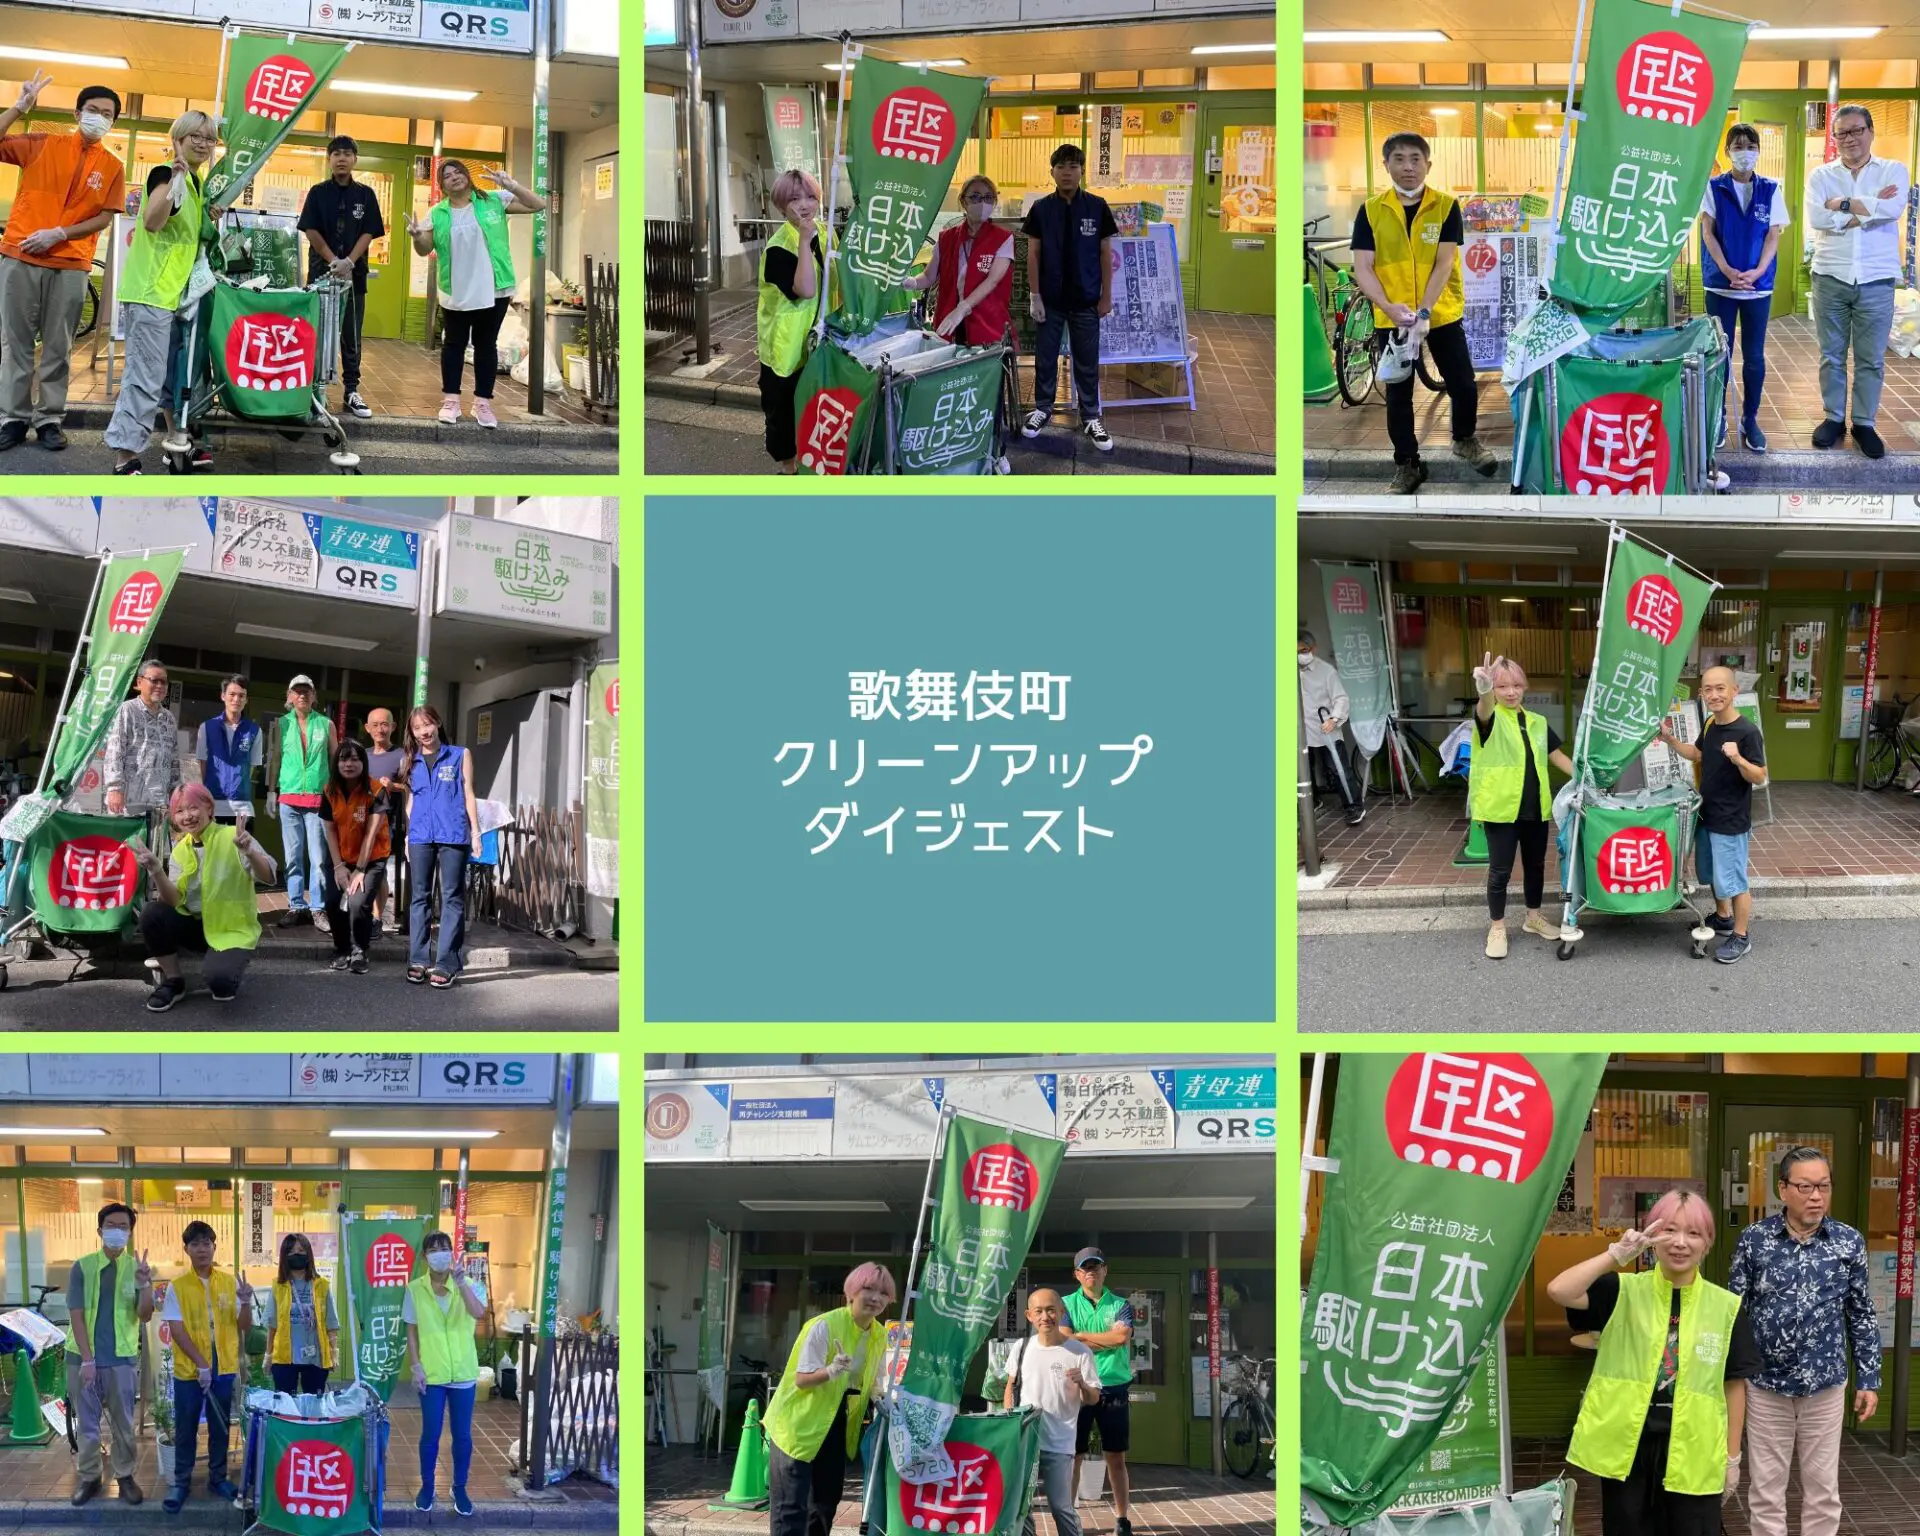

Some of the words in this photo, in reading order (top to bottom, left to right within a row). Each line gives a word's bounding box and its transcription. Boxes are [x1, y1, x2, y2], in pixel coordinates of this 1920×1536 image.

[440, 11, 509, 36] QRS
[1620, 144, 1683, 167] 公益社団法人
[874, 179, 928, 198] 公益社団法人
[1609, 162, 1679, 207] 日本
[867, 194, 924, 232] 日本
[1471, 249, 1493, 270] 72
[933, 386, 978, 423] 日本
[900, 408, 994, 452] 駆け込み
[327, 523, 393, 555] 青母連
[514, 539, 552, 563] 日本
[257, 558, 310, 577] シーアンドエス
[335, 565, 398, 593] QRS
[494, 557, 571, 588] 駆け込み
[1612, 661, 1658, 697] 日本
[344, 1068, 410, 1083] シーアンドエス
[443, 1060, 526, 1088] QRS
[1182, 1073, 1263, 1100] 青母連
[1063, 1083, 1136, 1098] 韓日旅行社
[1063, 1106, 1168, 1121] アルプス不動産
[1084, 1127, 1099, 1140] (株)
[1104, 1125, 1166, 1140] シーアンドエス
[1197, 1117, 1275, 1140] QRS
[551, 1172, 567, 1241] 歌舞伎町
[1390, 1210, 1496, 1247] 公益社団法人
[1898, 1184, 1917, 1295] よろず相談研究所
[956, 1238, 1010, 1270] 日本
[1371, 1241, 1489, 1312] 日本
[544, 1250, 561, 1334] 駆け込み寺
